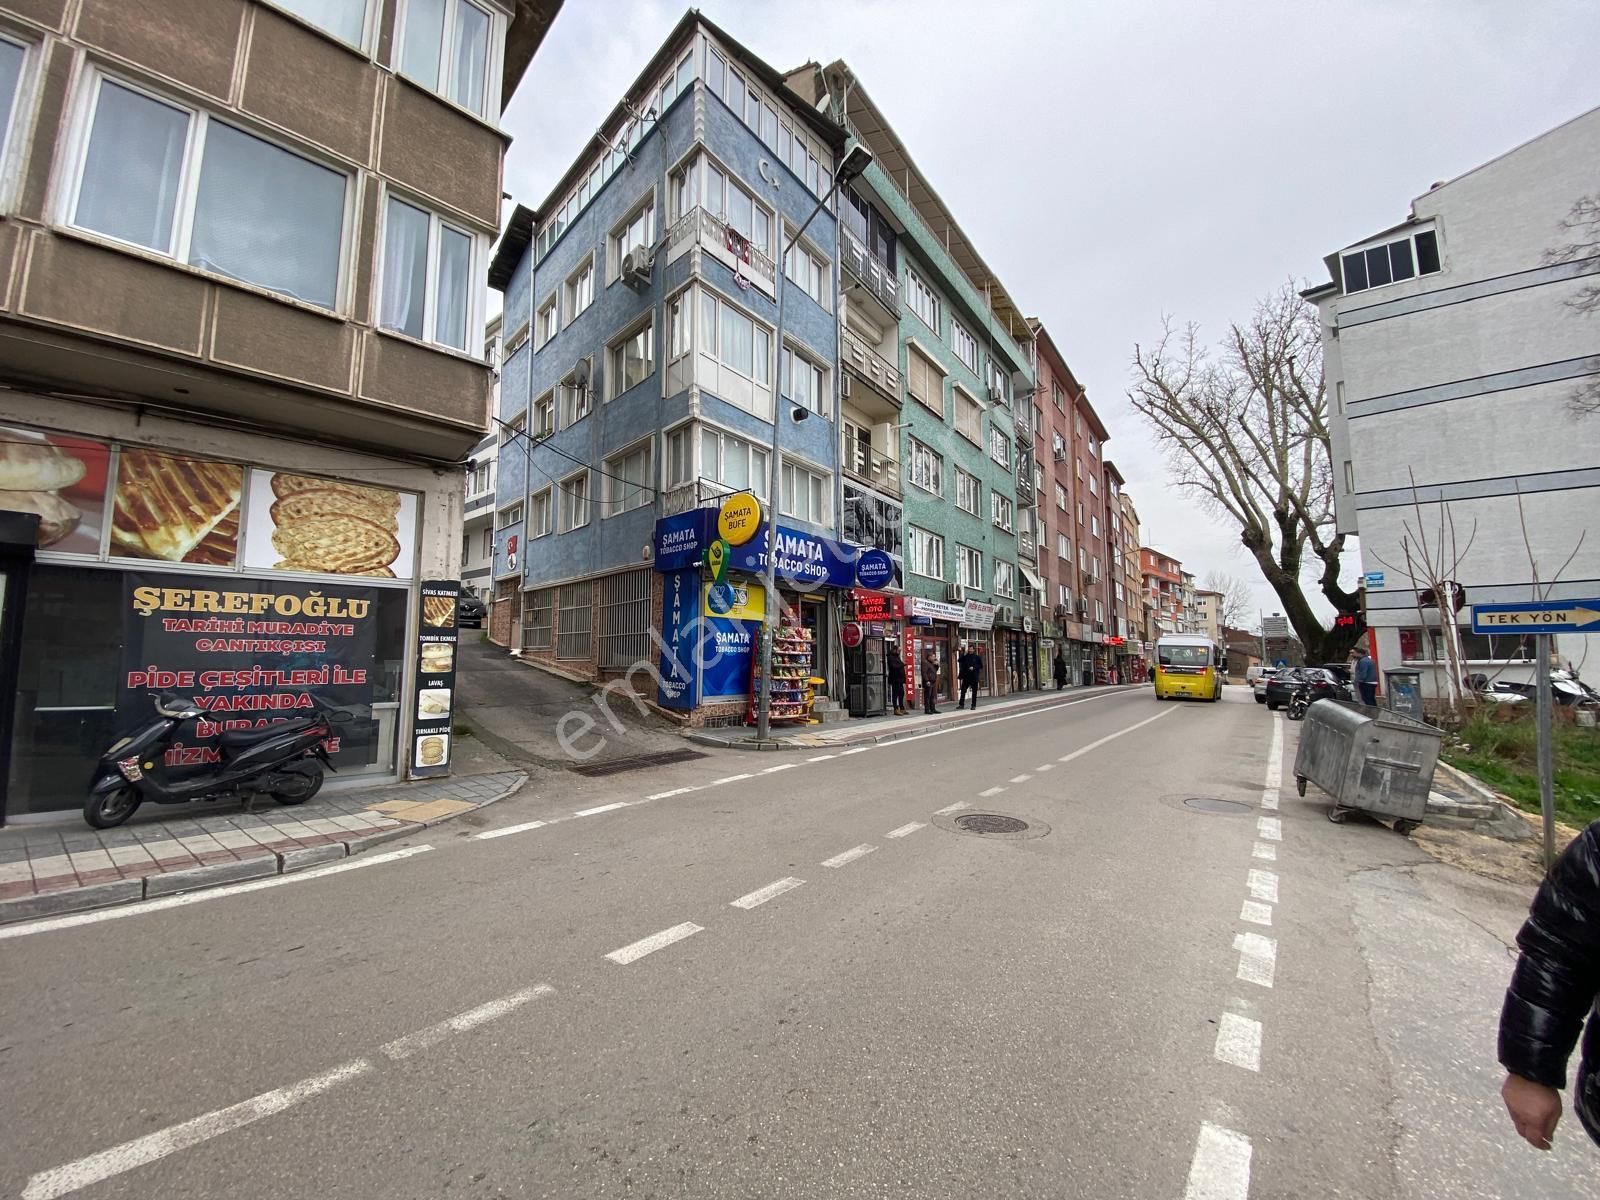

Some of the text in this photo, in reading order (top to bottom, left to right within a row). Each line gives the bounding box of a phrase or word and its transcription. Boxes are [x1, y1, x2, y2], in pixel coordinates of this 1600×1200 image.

[724, 507, 752, 521] ŞAMATA
[662, 528, 695, 547] ŞAMATA
[660, 541, 698, 556] TOBACCO SHOP
[804, 564, 828, 578] SHOP
[861, 562, 887, 572] ŞAMATA
[133, 586, 371, 619] ŞEREFOĞLU
[1487, 611, 1567, 624] TEK YÖN
[162, 617, 354, 636] TARİHİ MURADİYE
[716, 632, 750, 645] ŞAMATA
[195, 638, 326, 655] CANTIKÇISI
[127, 664, 367, 691] PİDE ÇEŞİTLERİ İLE
[661, 680, 686, 690] TOBACCO
[666, 689, 681, 698] SHOP
[193, 692, 315, 712] YAKINDA
